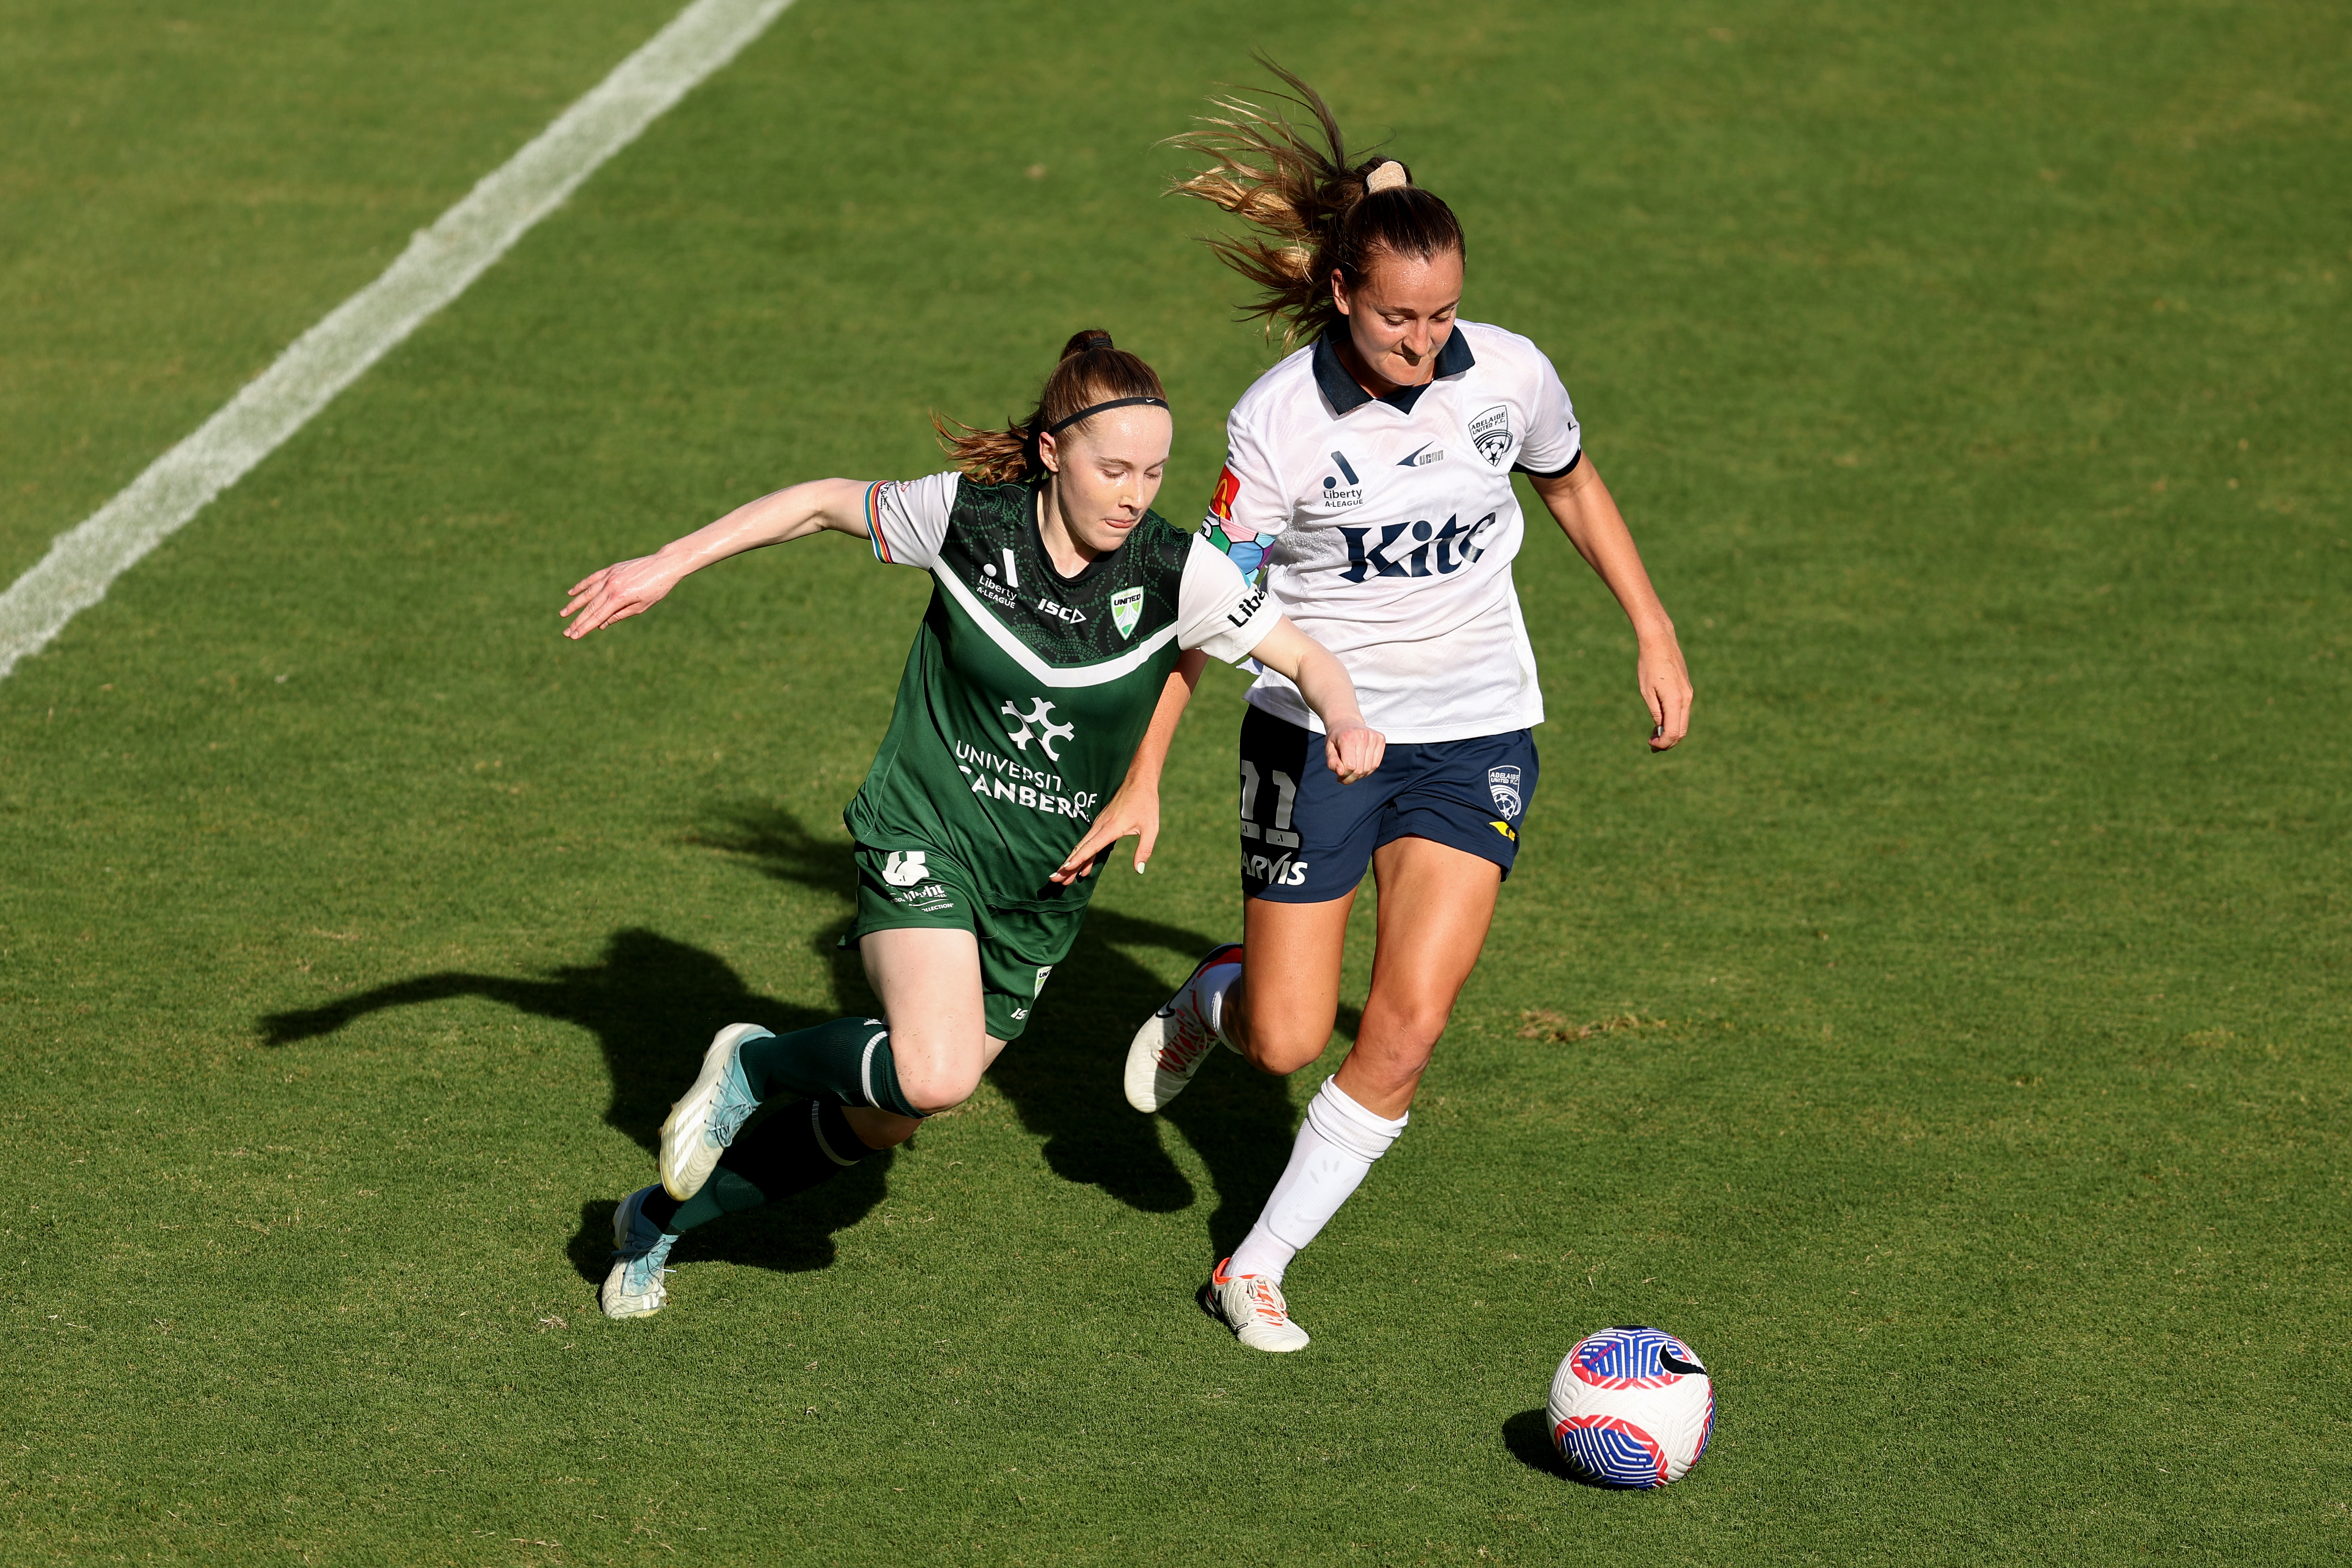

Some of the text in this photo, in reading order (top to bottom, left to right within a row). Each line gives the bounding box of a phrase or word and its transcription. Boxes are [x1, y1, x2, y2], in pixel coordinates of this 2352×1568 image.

[1471, 412, 1506, 430] ADELAIDE
[1473, 423, 1493, 435] UNITED
[1419, 449, 1444, 466] UCAN
[1323, 489, 1362, 499] Liberty
[1325, 498, 1363, 507] A-LEAGUE
[979, 575, 1017, 601] Liberty
[976, 586, 1016, 609] A-LEAGUE
[1114, 594, 1141, 606] UNITED
[956, 740, 1097, 808] UNIVERSIT OF
[1241, 759, 1299, 848] 11
[1241, 851, 1308, 886] ARVIS
[1010, 1007, 1028, 1020] IS
